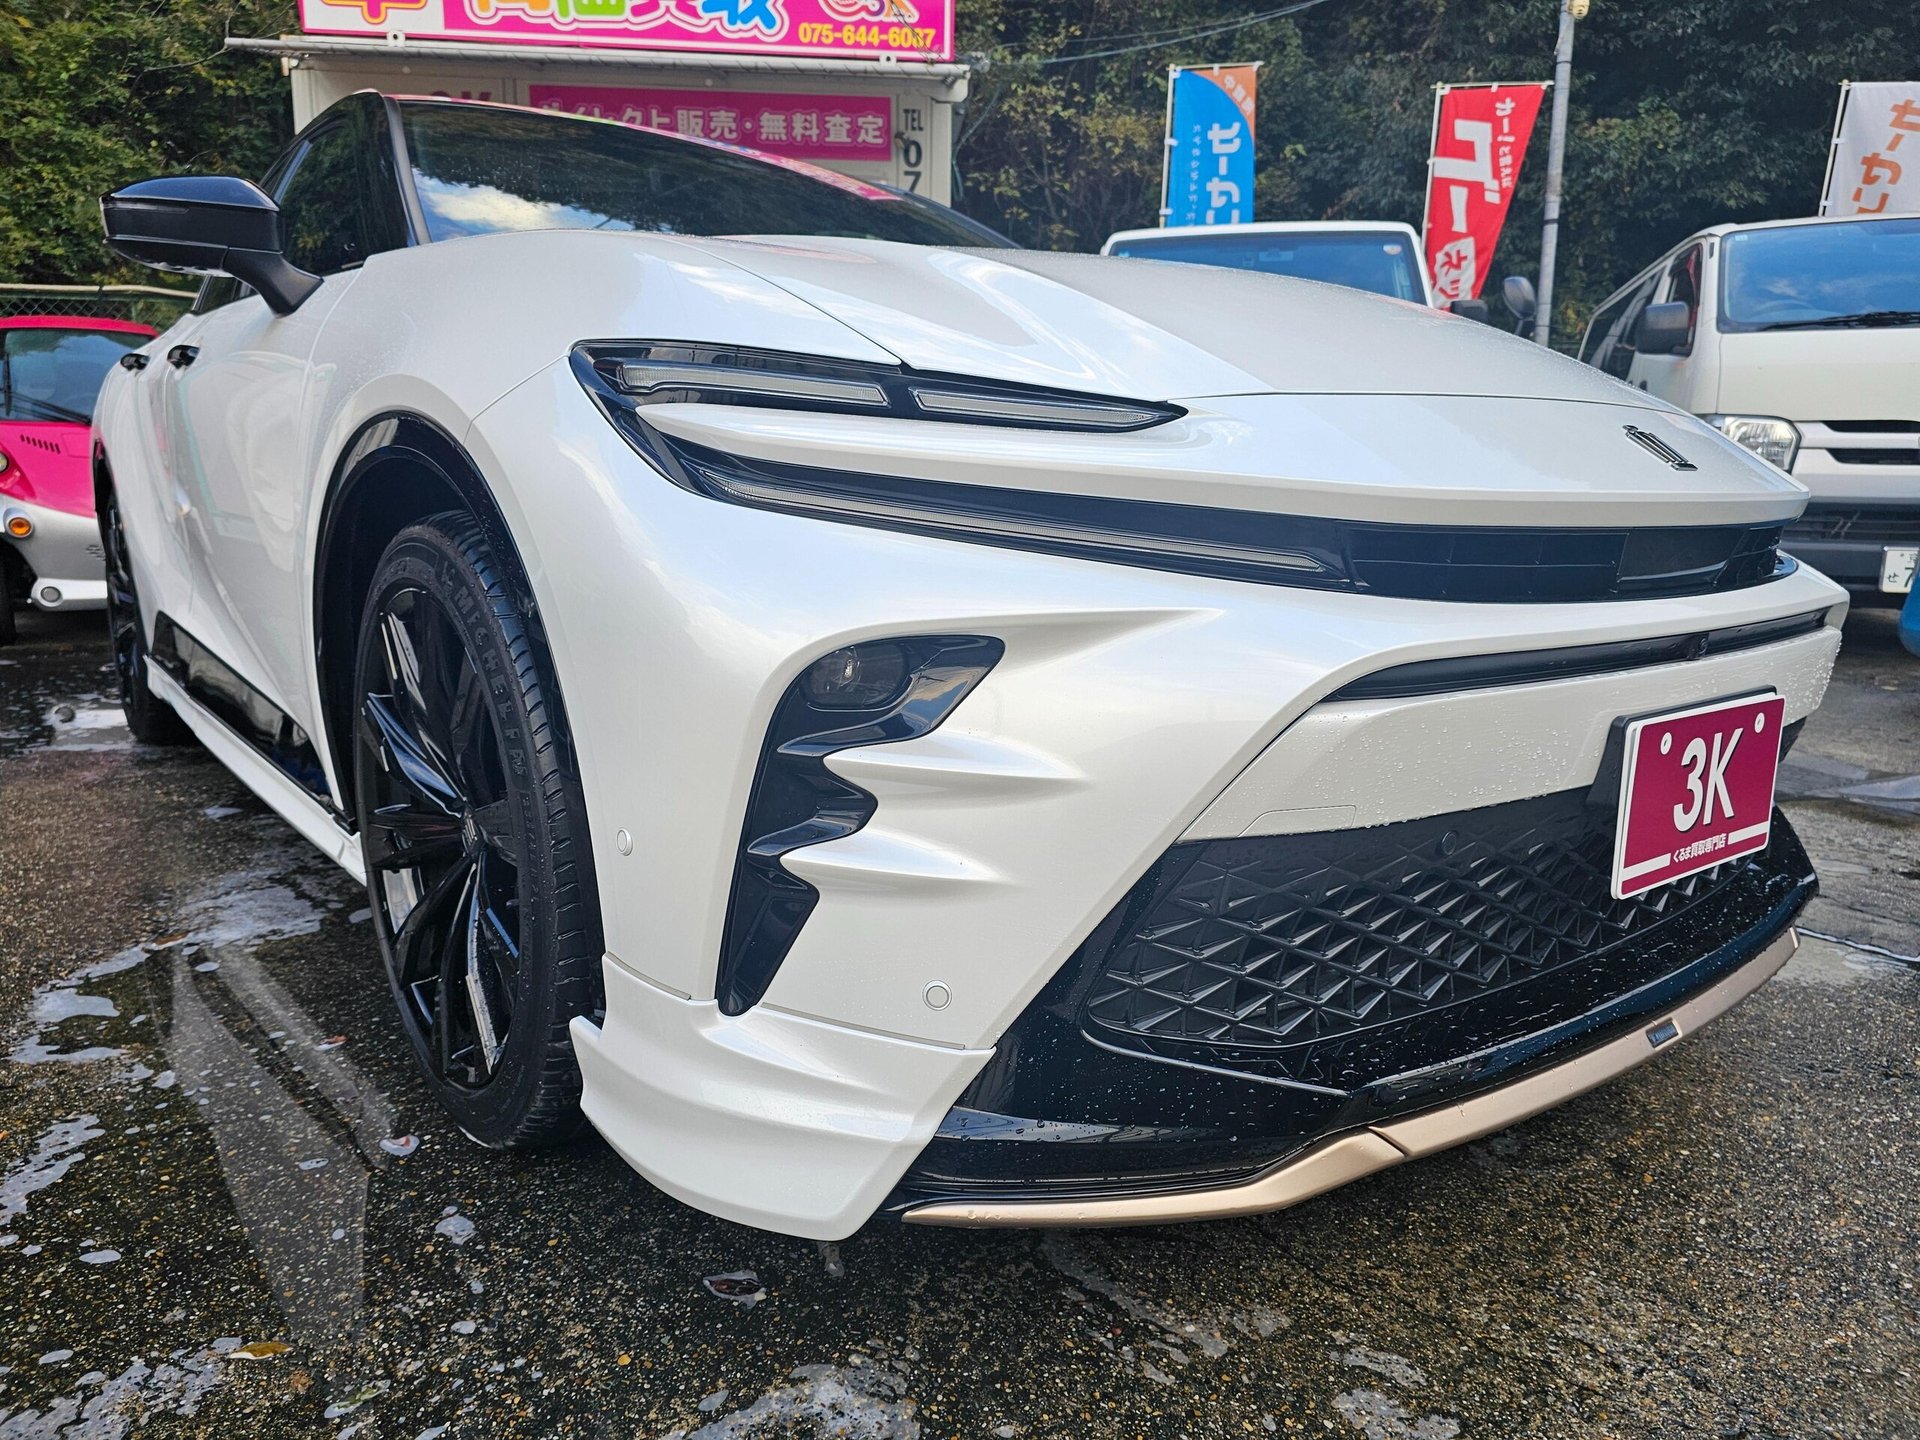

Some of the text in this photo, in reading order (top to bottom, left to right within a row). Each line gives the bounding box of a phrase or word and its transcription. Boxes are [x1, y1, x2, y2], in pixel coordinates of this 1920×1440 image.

[903, 108, 924, 131] TEL
[455, 586, 528, 777] MICHELIN
[1673, 727, 1744, 833] 3K
